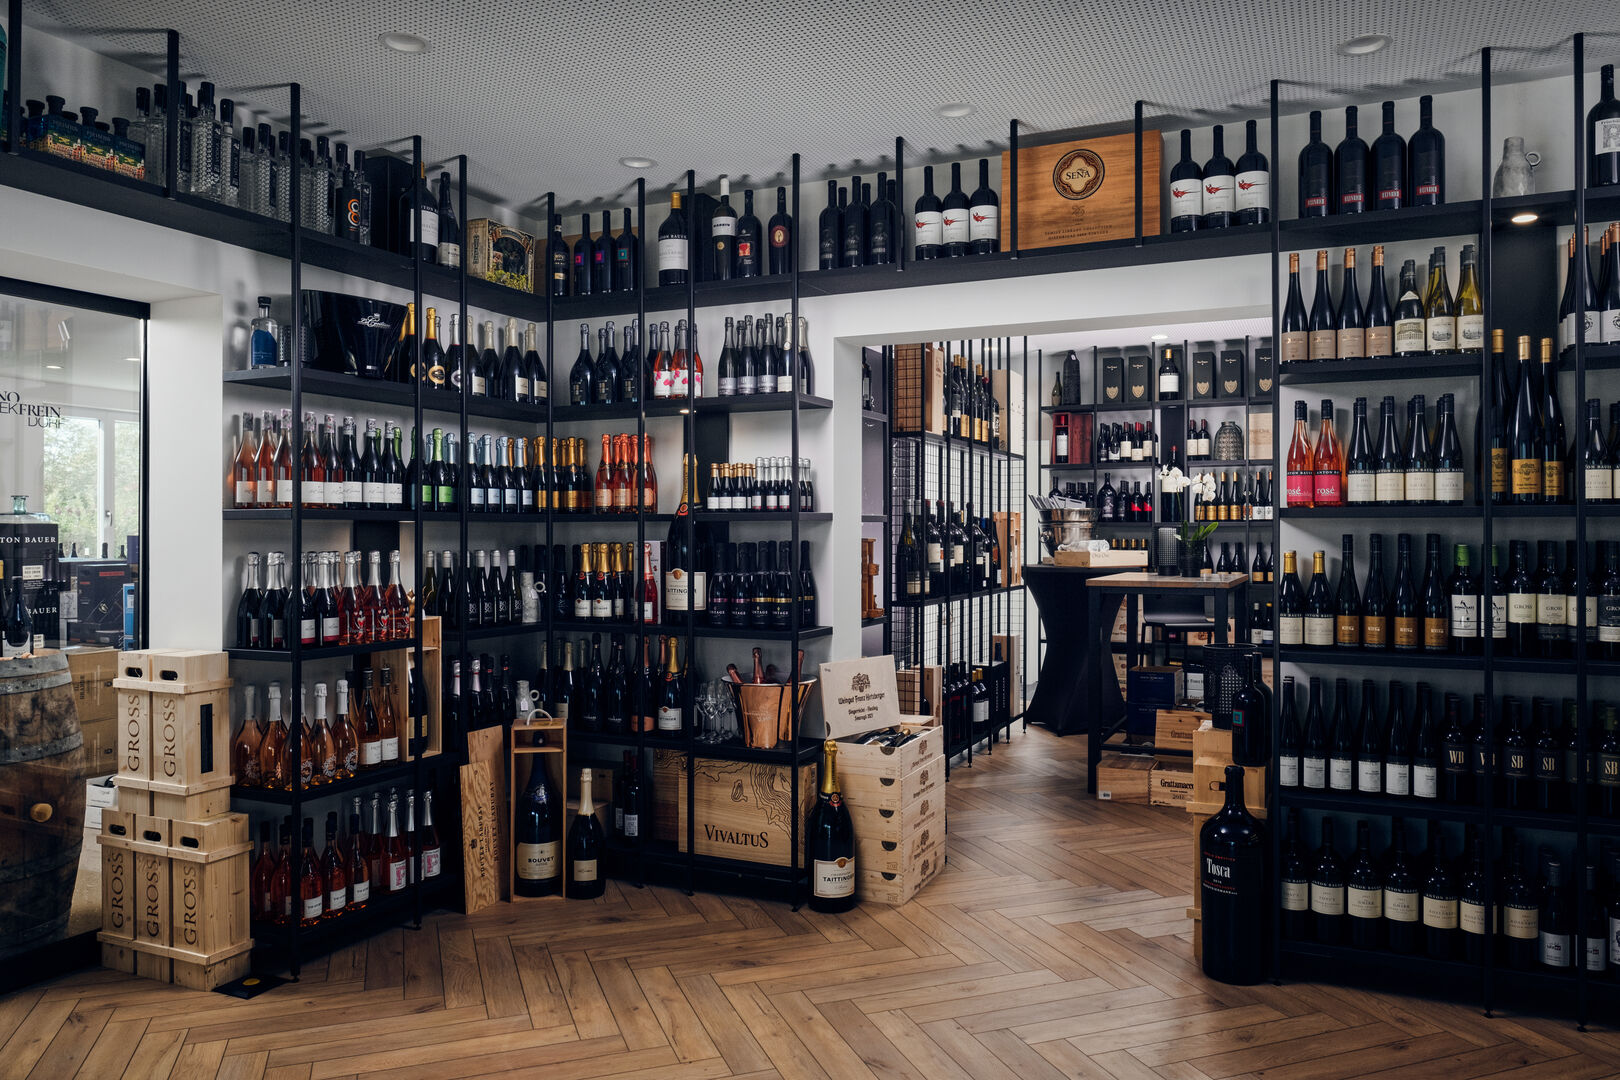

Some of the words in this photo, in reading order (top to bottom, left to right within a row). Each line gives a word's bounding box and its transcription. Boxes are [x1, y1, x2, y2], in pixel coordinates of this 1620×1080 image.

[1317, 485, 1336, 496] rosé
[127, 694, 140, 772] GROSS
[163, 697, 176, 778] GROSS
[1448, 750, 1465, 765] WB
[1511, 754, 1524, 769] SB
[1541, 757, 1556, 772] SB
[704, 823, 769, 848] VIVALTUS
[1206, 857, 1231, 879] Tosca
[111, 851, 124, 929] GROSS
[146, 859, 160, 938] GROSS
[184, 864, 197, 946] GROSS
